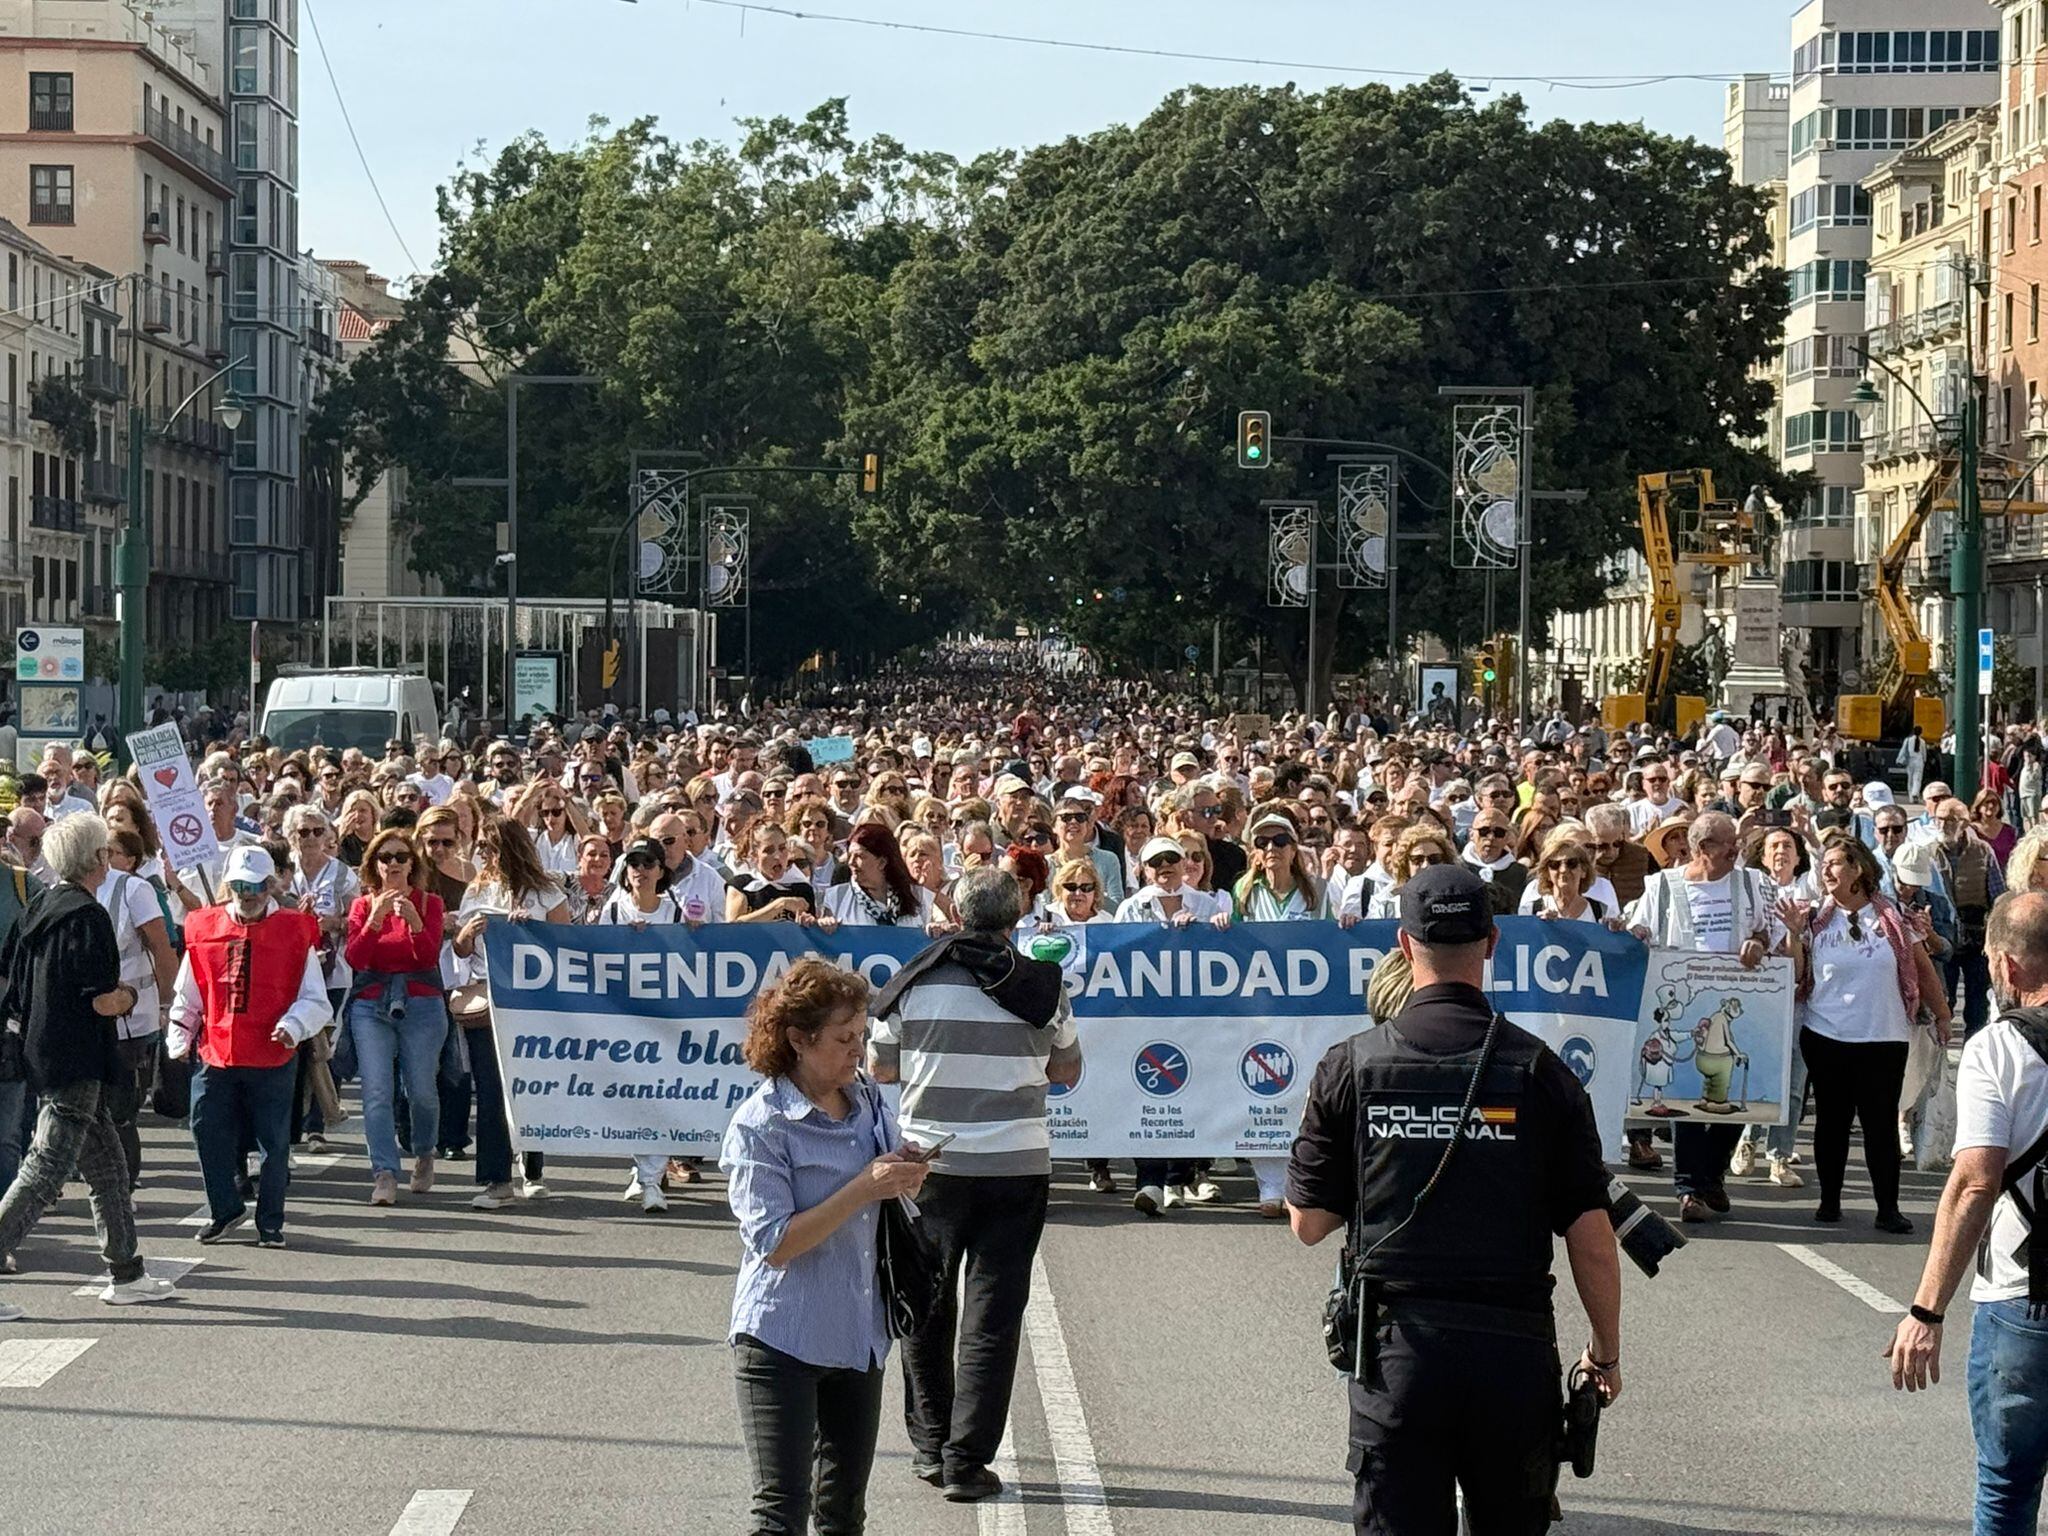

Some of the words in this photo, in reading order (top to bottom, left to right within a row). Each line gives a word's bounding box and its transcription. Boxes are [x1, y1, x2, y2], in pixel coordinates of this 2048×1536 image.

[512, 944, 902, 999] DEFENDAO
[1348, 944, 1610, 998] PLICA
[512, 1034, 662, 1065] marea
[677, 1029, 746, 1066] bla
[512, 1077, 559, 1100] por
[567, 1073, 595, 1097] la
[603, 1077, 719, 1101] sanidad
[725, 1080, 759, 1109] pú
[1064, 1105, 1073, 1115] la
[1142, 1105, 1157, 1115] No
[1167, 1105, 1182, 1115] los
[1248, 1105, 1263, 1115] No
[1274, 1105, 1288, 1115] las
[1047, 1117, 1088, 1127] tización
[1141, 1117, 1184, 1127] Recortes
[1254, 1117, 1284, 1127] Listas
[519, 1124, 591, 1141] abajador@s
[602, 1126, 659, 1142] Usuari@s
[669, 1128, 721, 1143] Vecin@s
[1049, 1129, 1089, 1140] Sanidad
[1129, 1130, 1141, 1139] en
[1144, 1129, 1153, 1139] la
[1155, 1129, 1196, 1140] Sanidad
[1244, 1129, 1256, 1139] de
[1258, 1130, 1291, 1141] espera
[1368, 1122, 1517, 1141] NACIONAL
